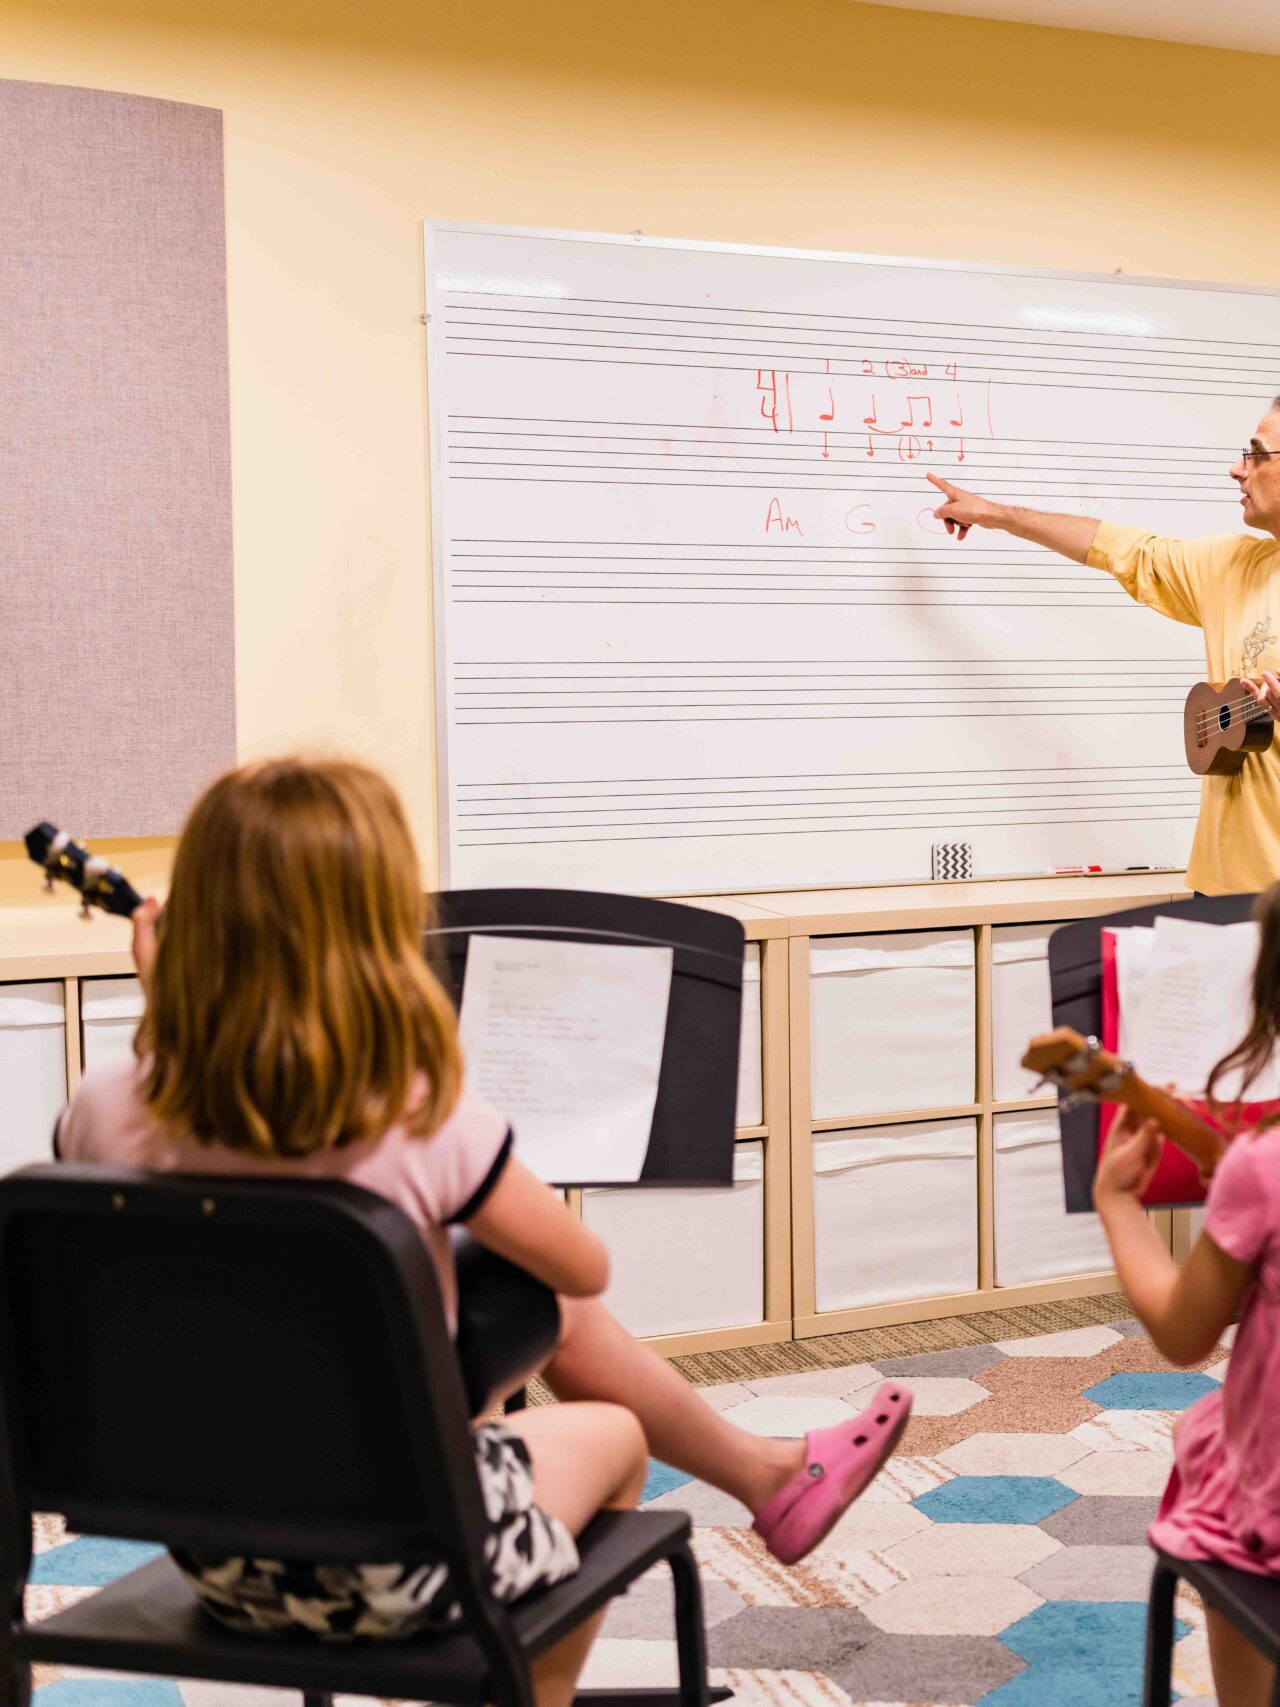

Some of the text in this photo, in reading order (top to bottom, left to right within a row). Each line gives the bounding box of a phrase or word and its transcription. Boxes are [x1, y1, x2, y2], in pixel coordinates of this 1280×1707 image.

[860, 359, 876, 375] 2
[945, 361, 958, 382] 4
[845, 504, 877, 535] G
